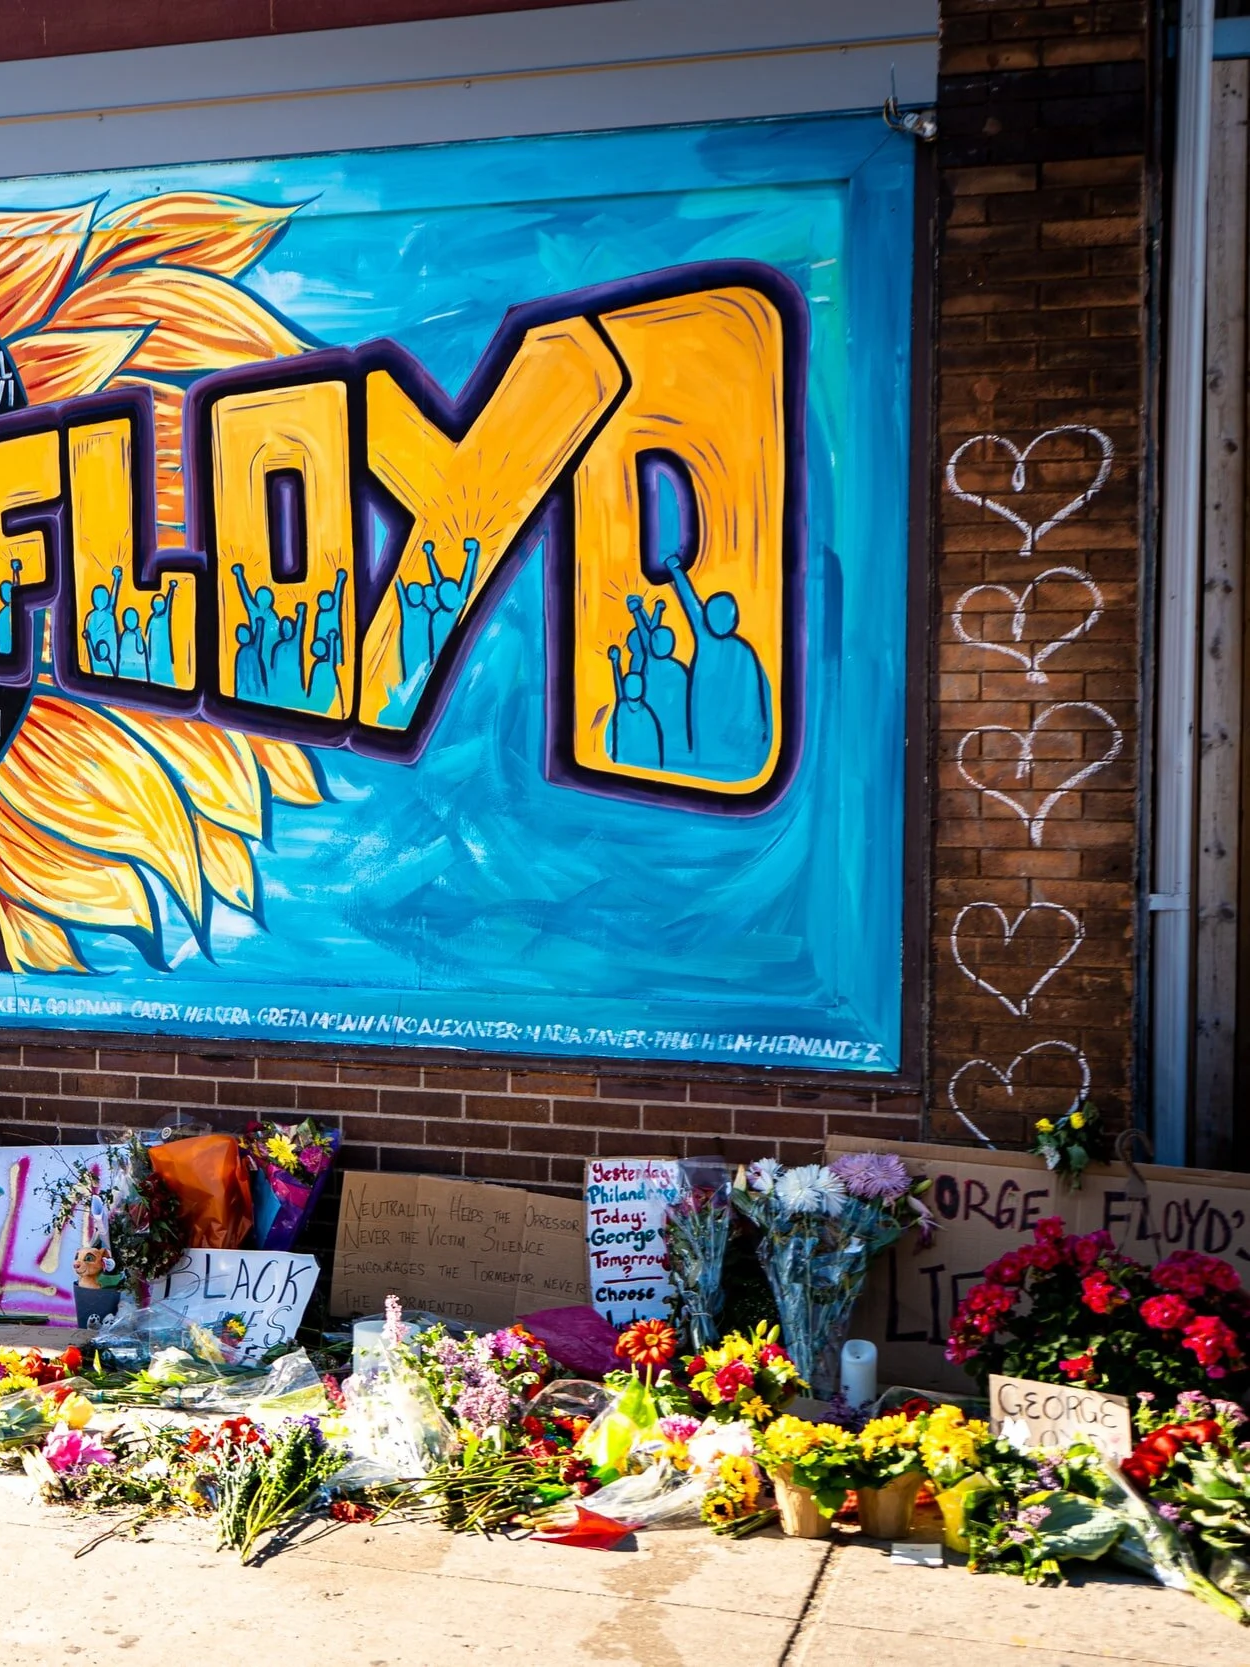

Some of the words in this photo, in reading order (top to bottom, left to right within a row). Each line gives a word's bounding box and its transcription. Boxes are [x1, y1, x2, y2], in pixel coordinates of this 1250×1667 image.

[46, 998, 123, 1016] GOLDMAN
[130, 1000, 182, 1021] CADEX
[183, 1005, 251, 1025] HERRERA
[257, 1007, 308, 1027] GRETA
[417, 1018, 518, 1041] ALEXANDER
[346, 1183, 436, 1223] NEUTRALITY
[450, 1194, 484, 1223] HELPS
[494, 1209, 511, 1223] THE
[343, 1220, 391, 1250] NEVER
[398, 1230, 420, 1246] THE
[480, 1226, 546, 1256] SILENCE
[164, 1253, 312, 1305] BLACK
[341, 1252, 427, 1277] ENCOURAGES
[438, 1264, 459, 1278] THE
[543, 1278, 588, 1296] NEVER
[341, 1288, 371, 1311] THE
[595, 1287, 656, 1303] Choose
[998, 1383, 1119, 1429] GEORGE
